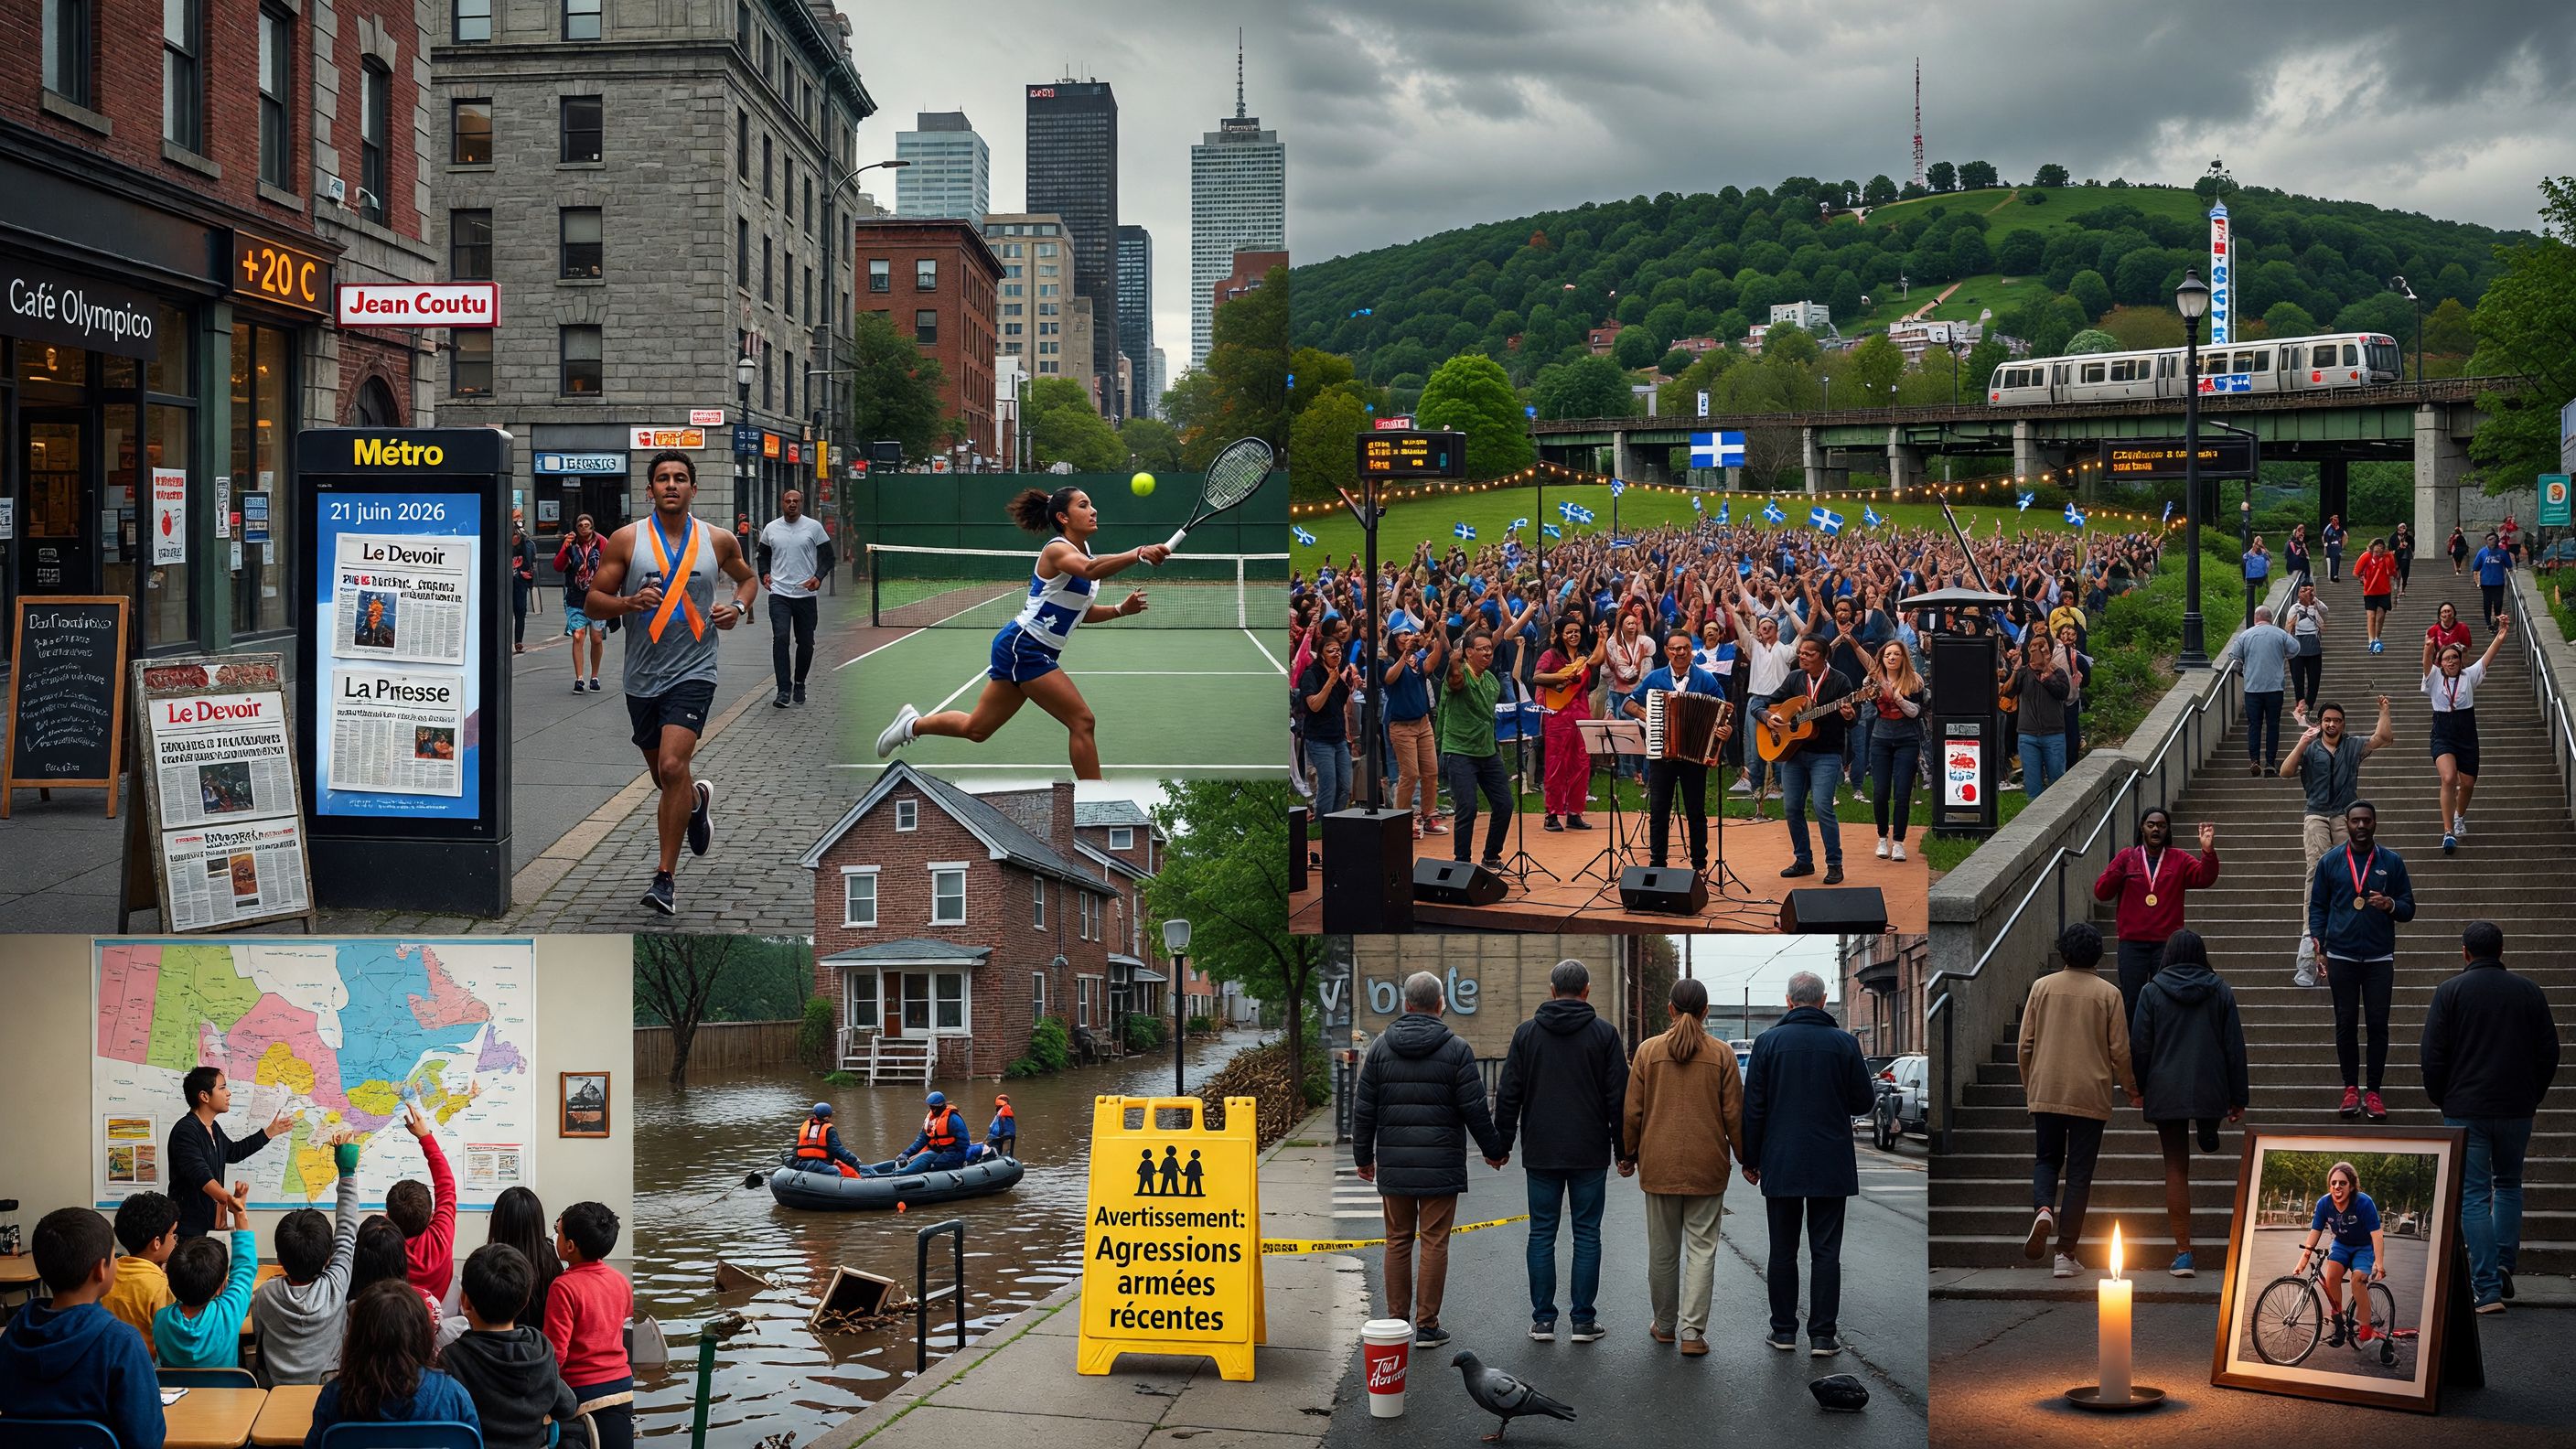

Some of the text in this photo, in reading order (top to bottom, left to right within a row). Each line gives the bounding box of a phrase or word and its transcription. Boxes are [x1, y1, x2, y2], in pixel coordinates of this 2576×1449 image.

[242, 248, 317, 303] +20 C
[9, 278, 152, 342] Café Olympico
[349, 291, 487, 315] Jean Coutu
[353, 438, 444, 466] Métro
[330, 502, 445, 525] 21 juin 2026
[363, 542, 445, 565] Le Devoir
[344, 676, 371, 700] La
[167, 698, 263, 724] Le Devoir
[1094, 1206, 1246, 1229] Avertissement:
[1095, 1235, 1241, 1268] Agressions
[1117, 1269, 1216, 1296] armées
[1110, 1301, 1224, 1331] récentes
